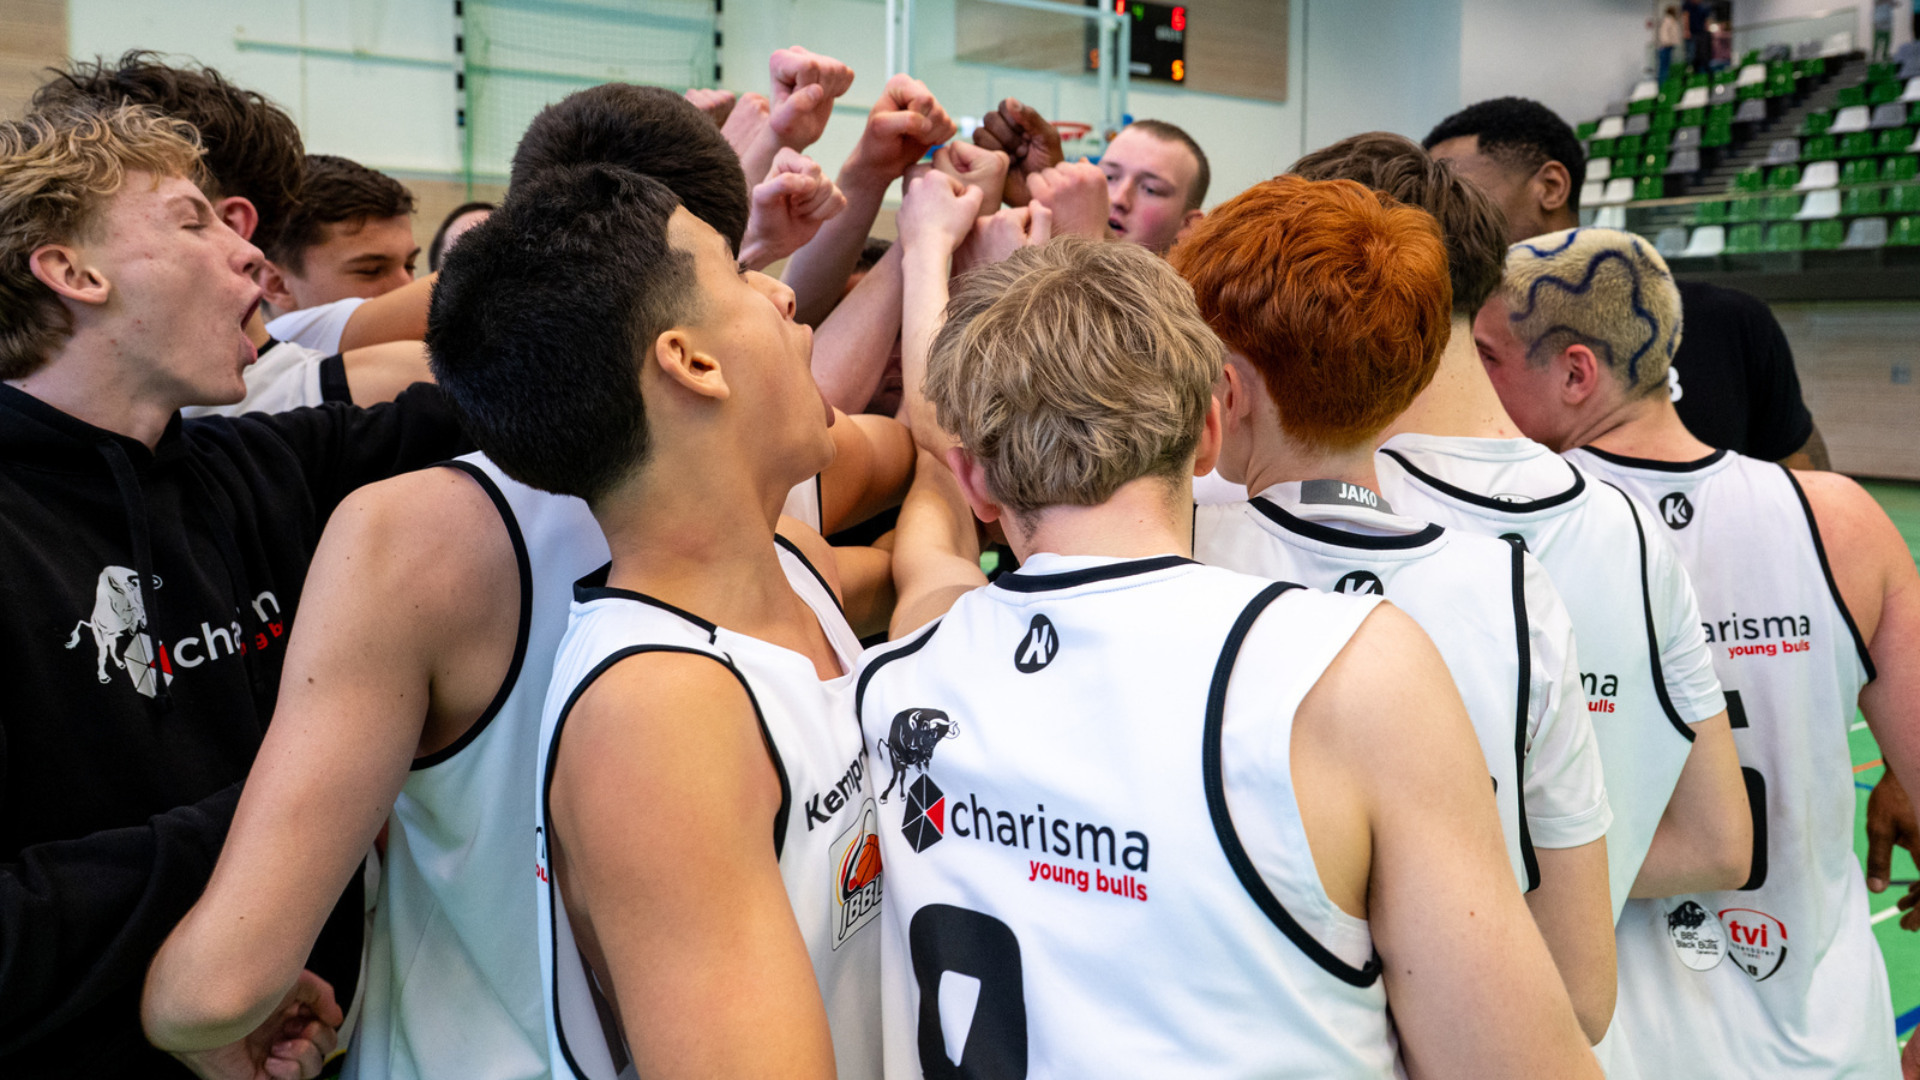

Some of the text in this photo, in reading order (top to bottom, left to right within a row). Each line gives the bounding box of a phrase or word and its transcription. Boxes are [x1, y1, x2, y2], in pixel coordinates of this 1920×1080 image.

[1338, 483, 1377, 507] JAKO
[1700, 612, 1811, 643] arisma
[1728, 644, 1777, 659] young
[1588, 699, 1615, 713] ulls
[951, 793, 1150, 873] charisma
[1029, 860, 1148, 902] young bulls
[838, 874, 883, 941] JBBL
[1680, 931, 1699, 941] BBC
[1729, 920, 1767, 947] tvi
